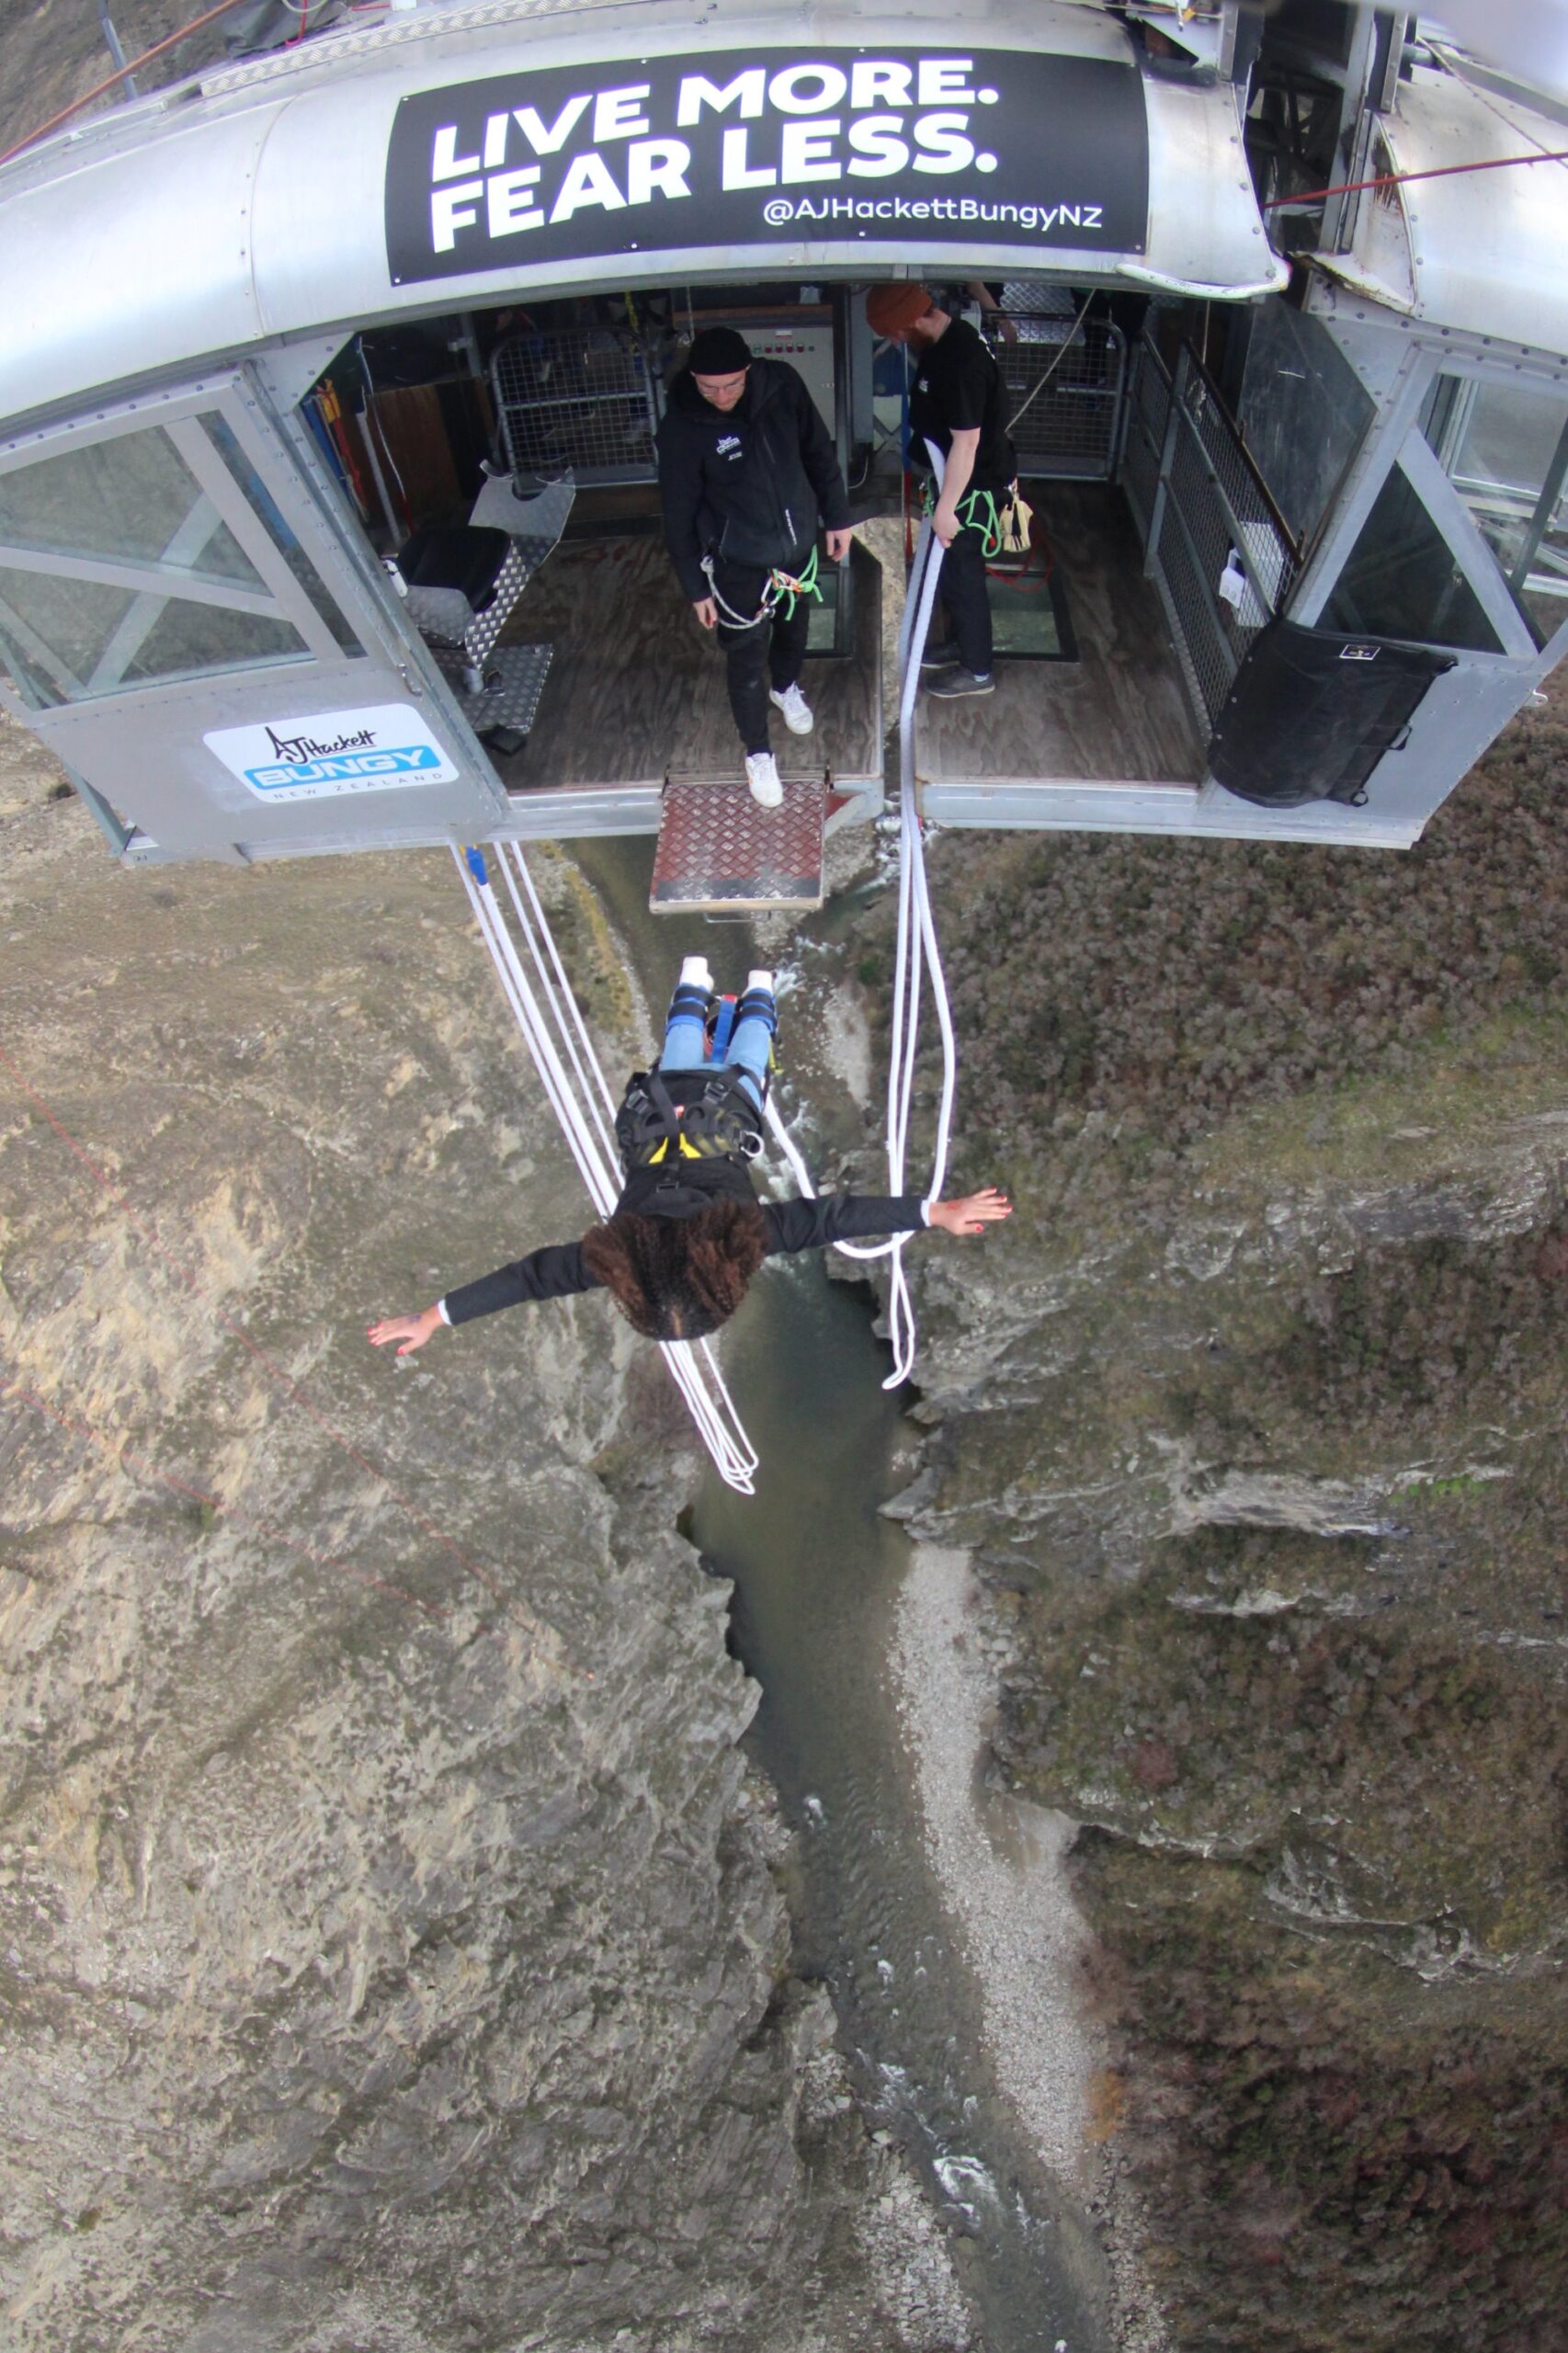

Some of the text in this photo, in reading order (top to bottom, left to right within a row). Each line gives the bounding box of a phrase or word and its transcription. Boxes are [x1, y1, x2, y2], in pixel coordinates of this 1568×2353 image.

[432, 59, 999, 182] LIVE MORE.
[431, 112, 997, 253] FEAR LESS.
[763, 197, 1103, 233] @AJHackettBungyNZ
[253, 750, 424, 785] BUNGY
[273, 772, 443, 800] NEW ZEALAND
